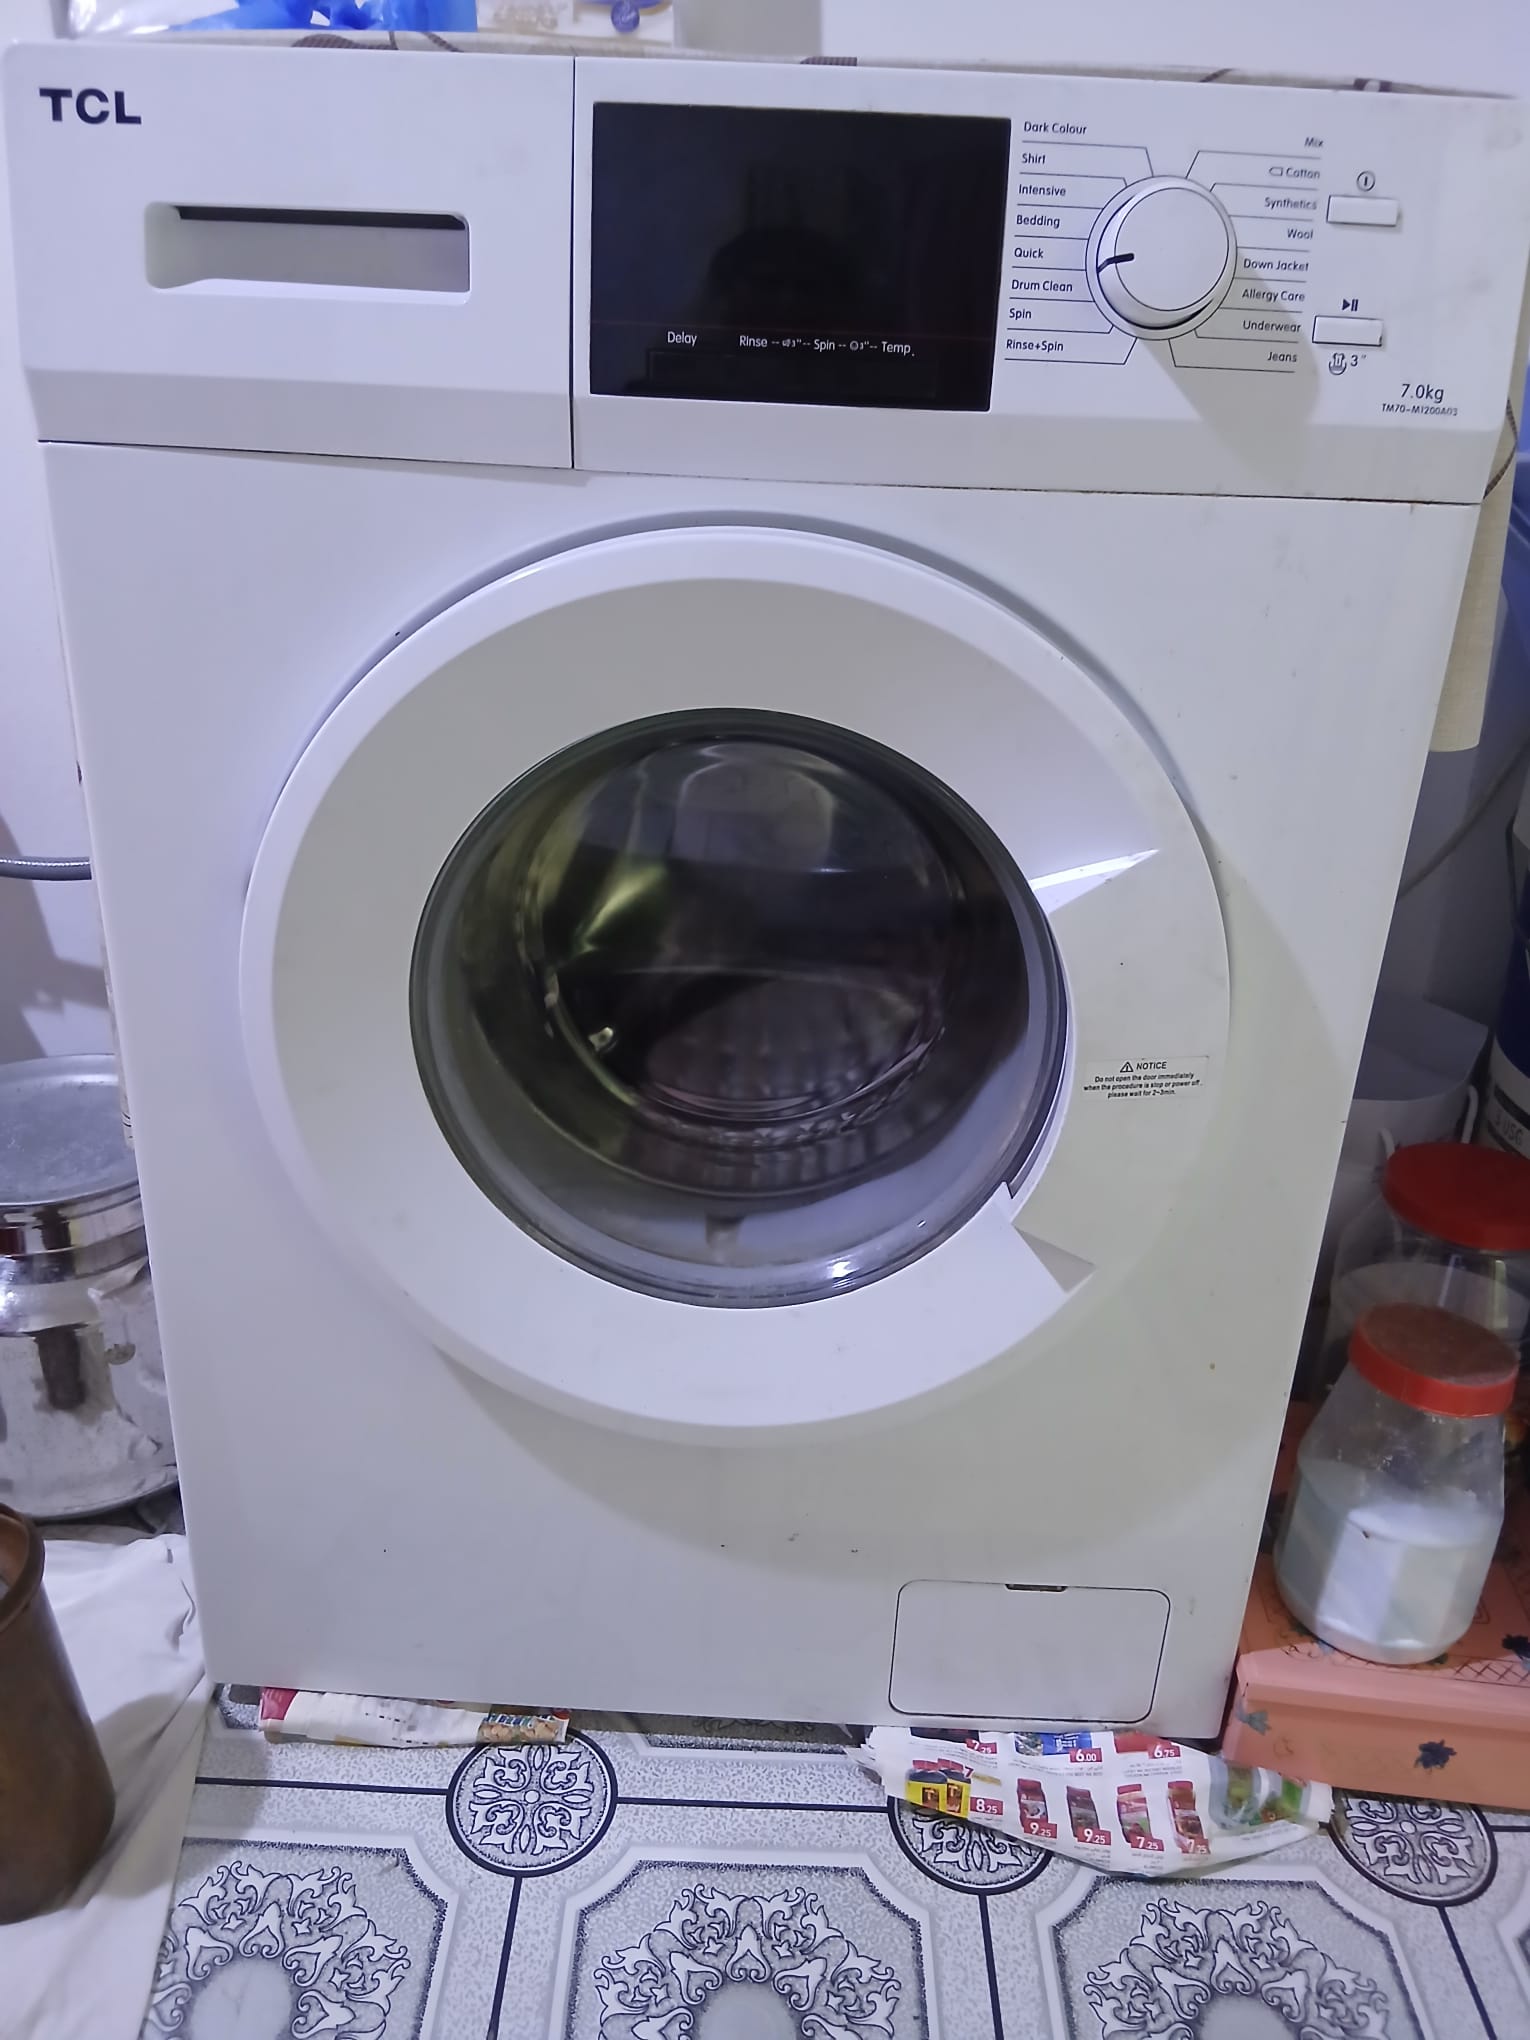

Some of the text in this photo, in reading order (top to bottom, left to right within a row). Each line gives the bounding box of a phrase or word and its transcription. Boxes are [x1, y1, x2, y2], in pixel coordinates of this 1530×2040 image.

[39, 87, 142, 125] TCL
[1023, 121, 1087, 135] Dark Colour
[1304, 136, 1324, 148] Mix
[1021, 153, 1046, 165] Shirt
[1285, 167, 1320, 179] Cotton
[1018, 184, 1067, 196] Intensive
[1264, 197, 1318, 210] Synthetics
[1016, 214, 1061, 229] Bedding
[1287, 228, 1314, 239] Wool
[1014, 247, 1044, 259] Quick
[1243, 258, 1309, 272] Down Jacket
[1011, 279, 1073, 292] Drum Clean
[1241, 288, 1306, 302] Allergy Care
[1009, 307, 1032, 321] Spin
[1242, 320, 1302, 333] Underwear
[667, 331, 698, 347] Delay
[739, 335, 768, 348] Rinse
[813, 338, 836, 352] Spin
[1006, 338, 1064, 353] Rinse+Spin
[1267, 351, 1298, 363] Jeans
[1400, 383, 1445, 404] 7.0kg
[1136, 1061, 1168, 1071] NOTICE
[1115, 1075, 1131, 1083] open
[1157, 1072, 1194, 1080] immediately
[1111, 1083, 1143, 1091] procedure
[1150, 1081, 1164, 1089] stop
[1171, 1081, 1190, 1089] power
[1107, 1091, 1129, 1100] please
[1142, 1089, 1152, 1097] for
[1075, 1749, 1097, 1762] 6.00
[1153, 1745, 1175, 1758] 6.75
[975, 1799, 998, 1814] 8.25
[1030, 1823, 1052, 1837] 9.25
[1083, 1829, 1106, 1843] 9.25
[1136, 1837, 1159, 1850] 7.25
